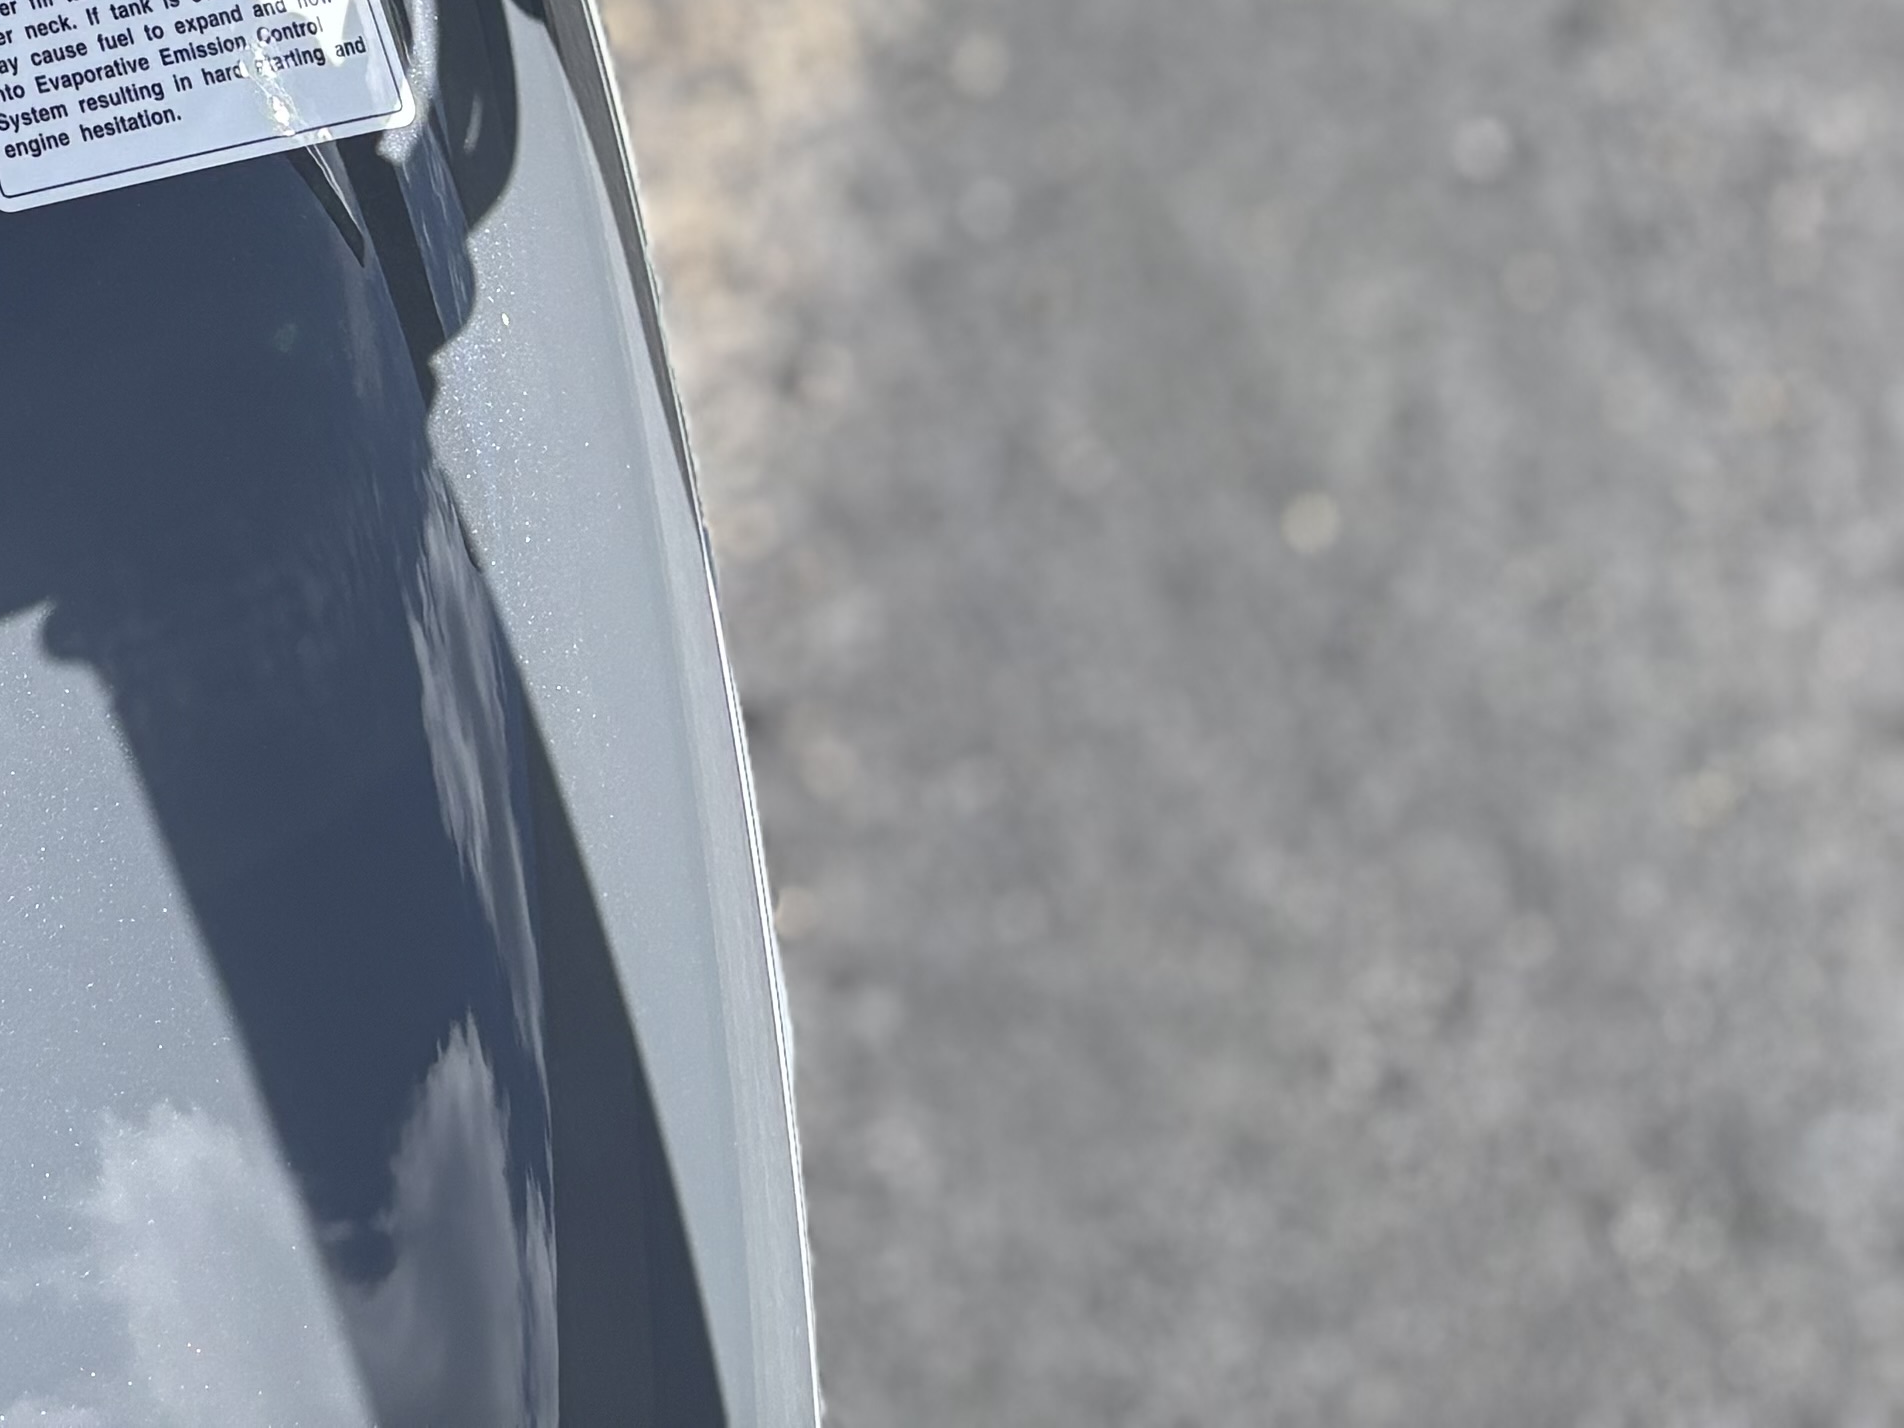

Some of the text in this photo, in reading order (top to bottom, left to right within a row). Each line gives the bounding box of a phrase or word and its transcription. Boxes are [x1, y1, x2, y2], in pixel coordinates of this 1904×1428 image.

[25, 15, 77, 40] neck.
[86, 7, 100, 26] If
[31, 43, 88, 66] cause
[97, 28, 135, 52] fuel
[144, 24, 164, 41] to
[175, 5, 243, 35] expand
[34, 57, 150, 94] Evaporative
[159, 36, 247, 67] Emission
[257, 16, 323, 43] Control
[78, 82, 165, 113] resulting
[172, 74, 193, 92] in
[335, 36, 366, 57] and
[4, 108, 181, 158] engine hesitation.
